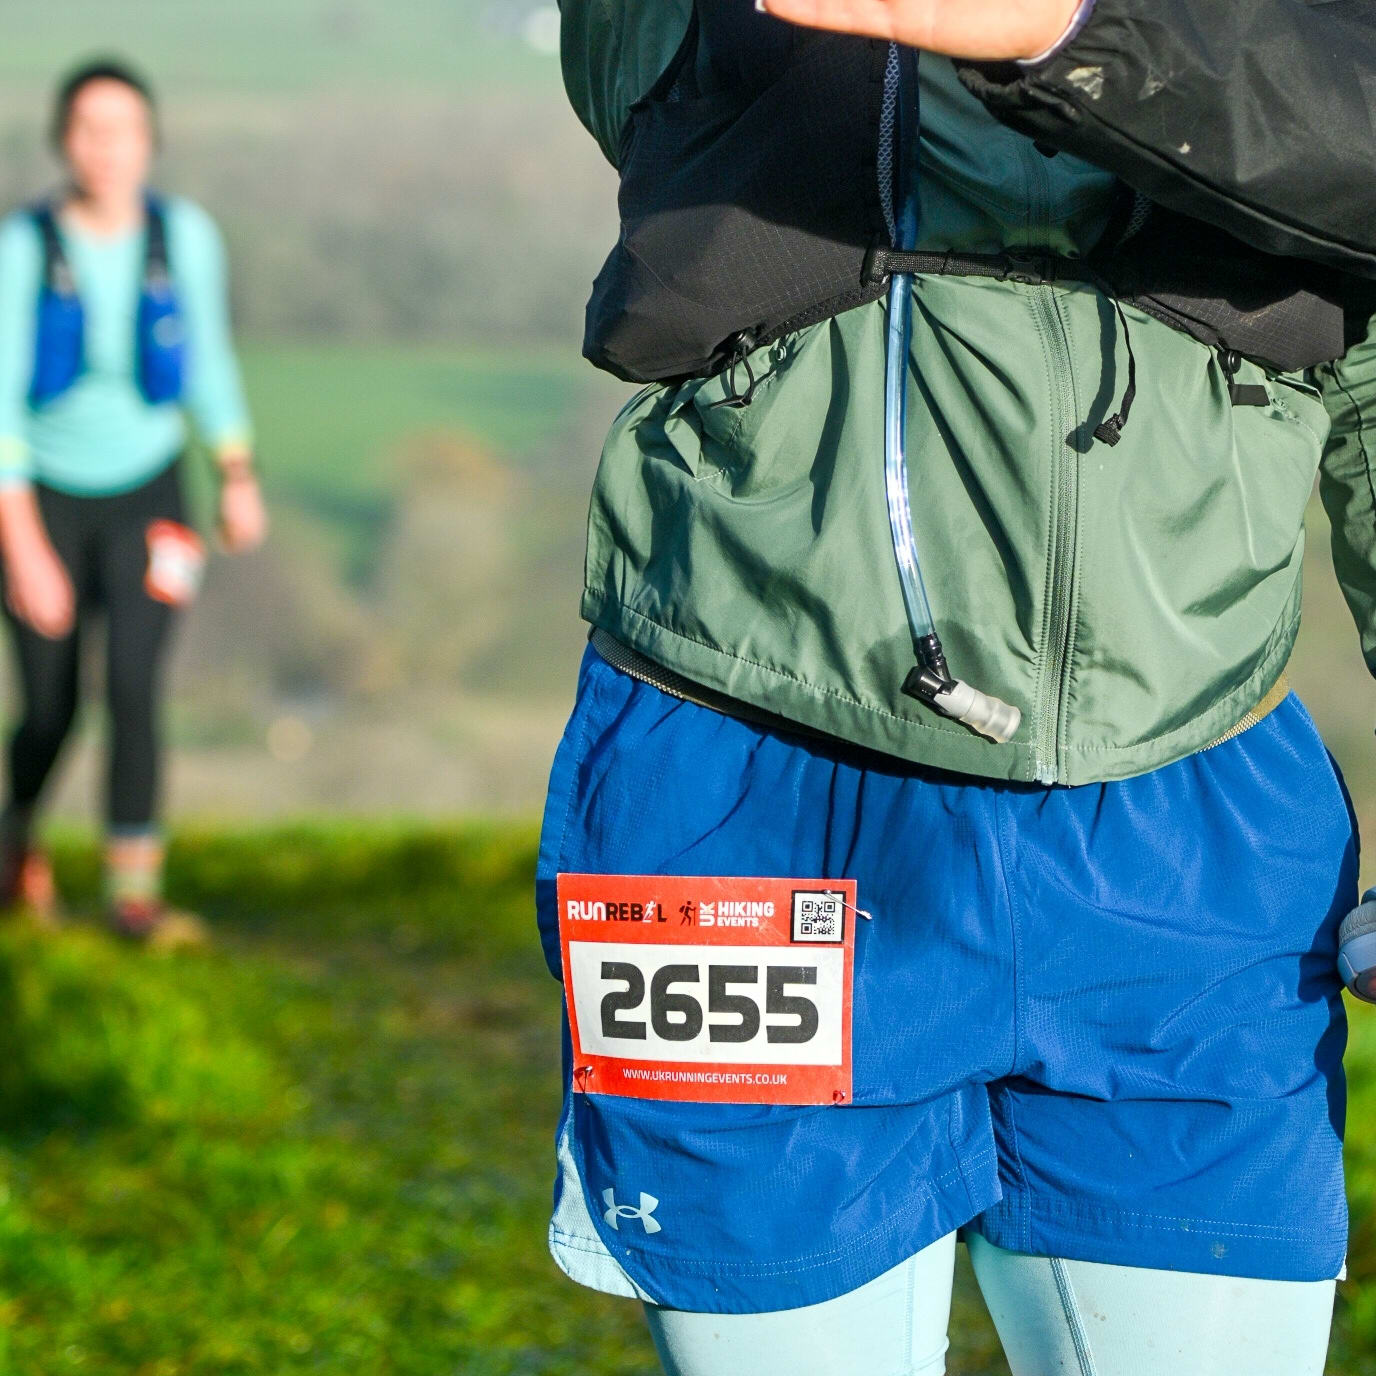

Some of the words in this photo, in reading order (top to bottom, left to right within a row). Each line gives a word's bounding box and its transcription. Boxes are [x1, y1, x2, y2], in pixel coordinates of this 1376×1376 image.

[699, 901, 716, 927] UK
[717, 901, 775, 917] HIKING
[717, 916, 760, 927] EVENTS
[600, 961, 819, 1044] 2655
[622, 1068, 788, 1086] WWW.UKRUNNINGEVENTS.CO.UK
